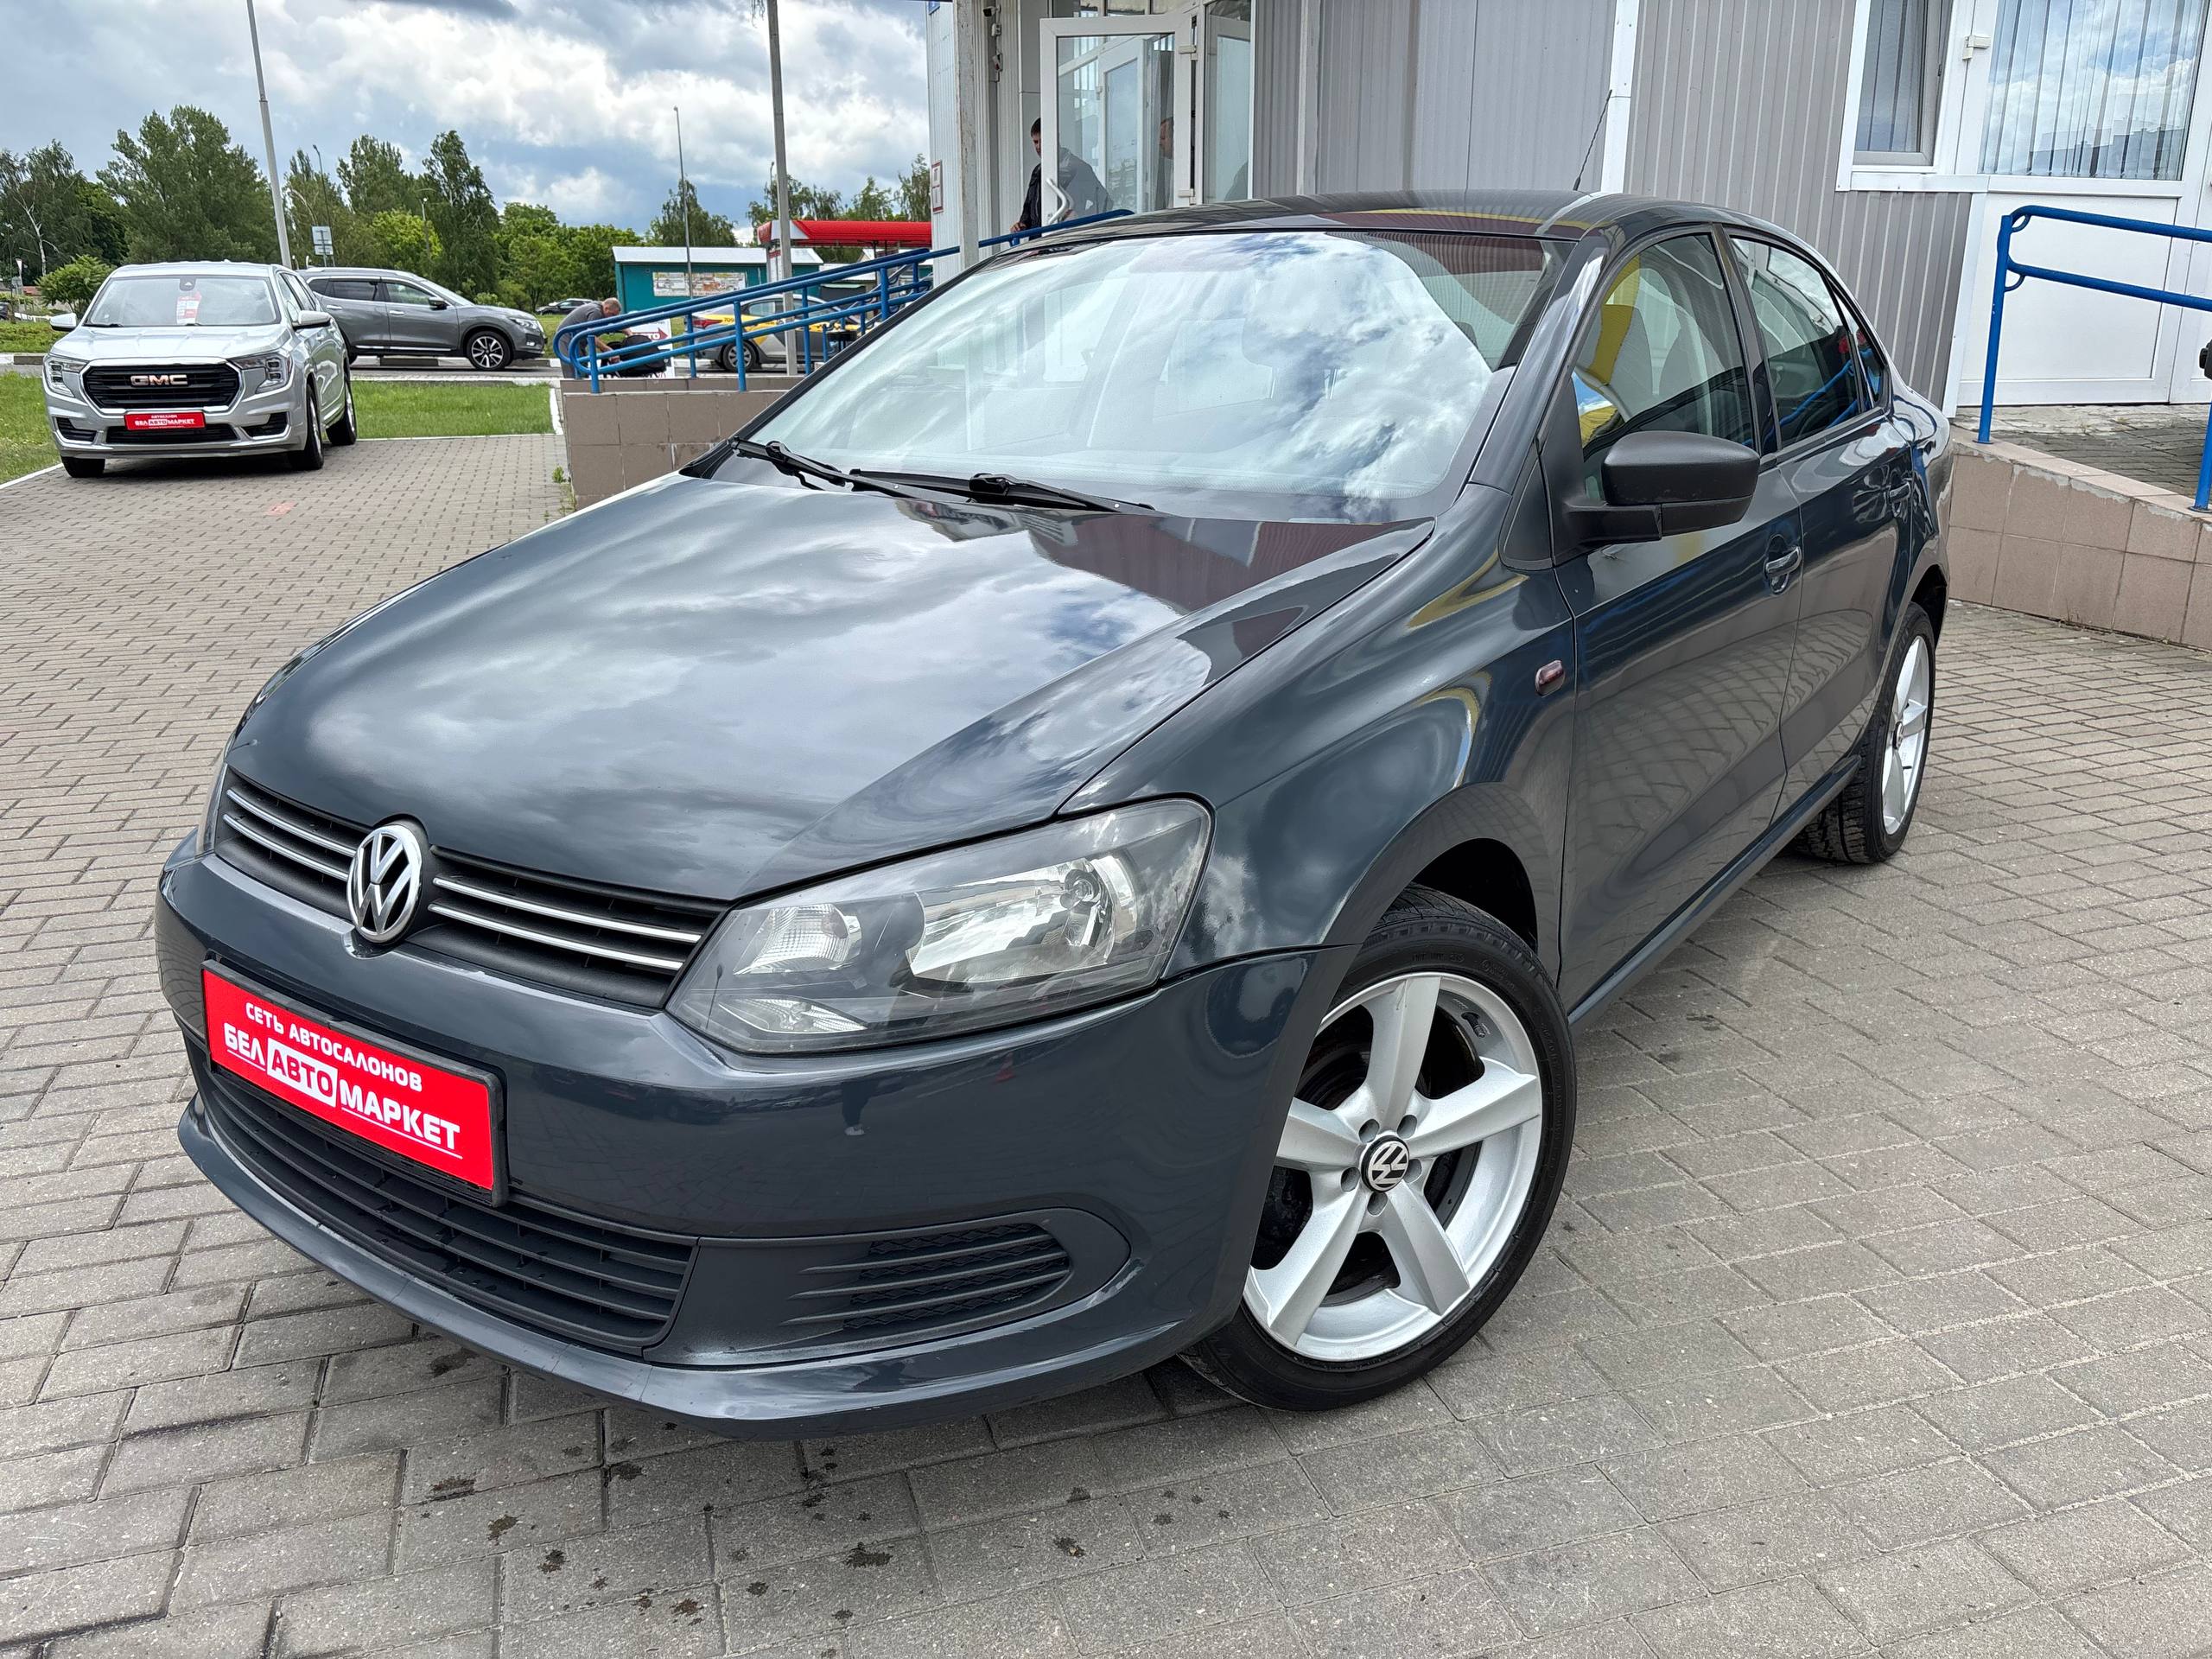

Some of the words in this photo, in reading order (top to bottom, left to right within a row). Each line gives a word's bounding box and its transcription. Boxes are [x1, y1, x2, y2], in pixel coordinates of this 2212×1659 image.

[130, 374, 188, 386] GMC
[245, 1002, 284, 1034] СЕТЬ
[289, 1026, 423, 1091] АВТОСАЛОНОВ
